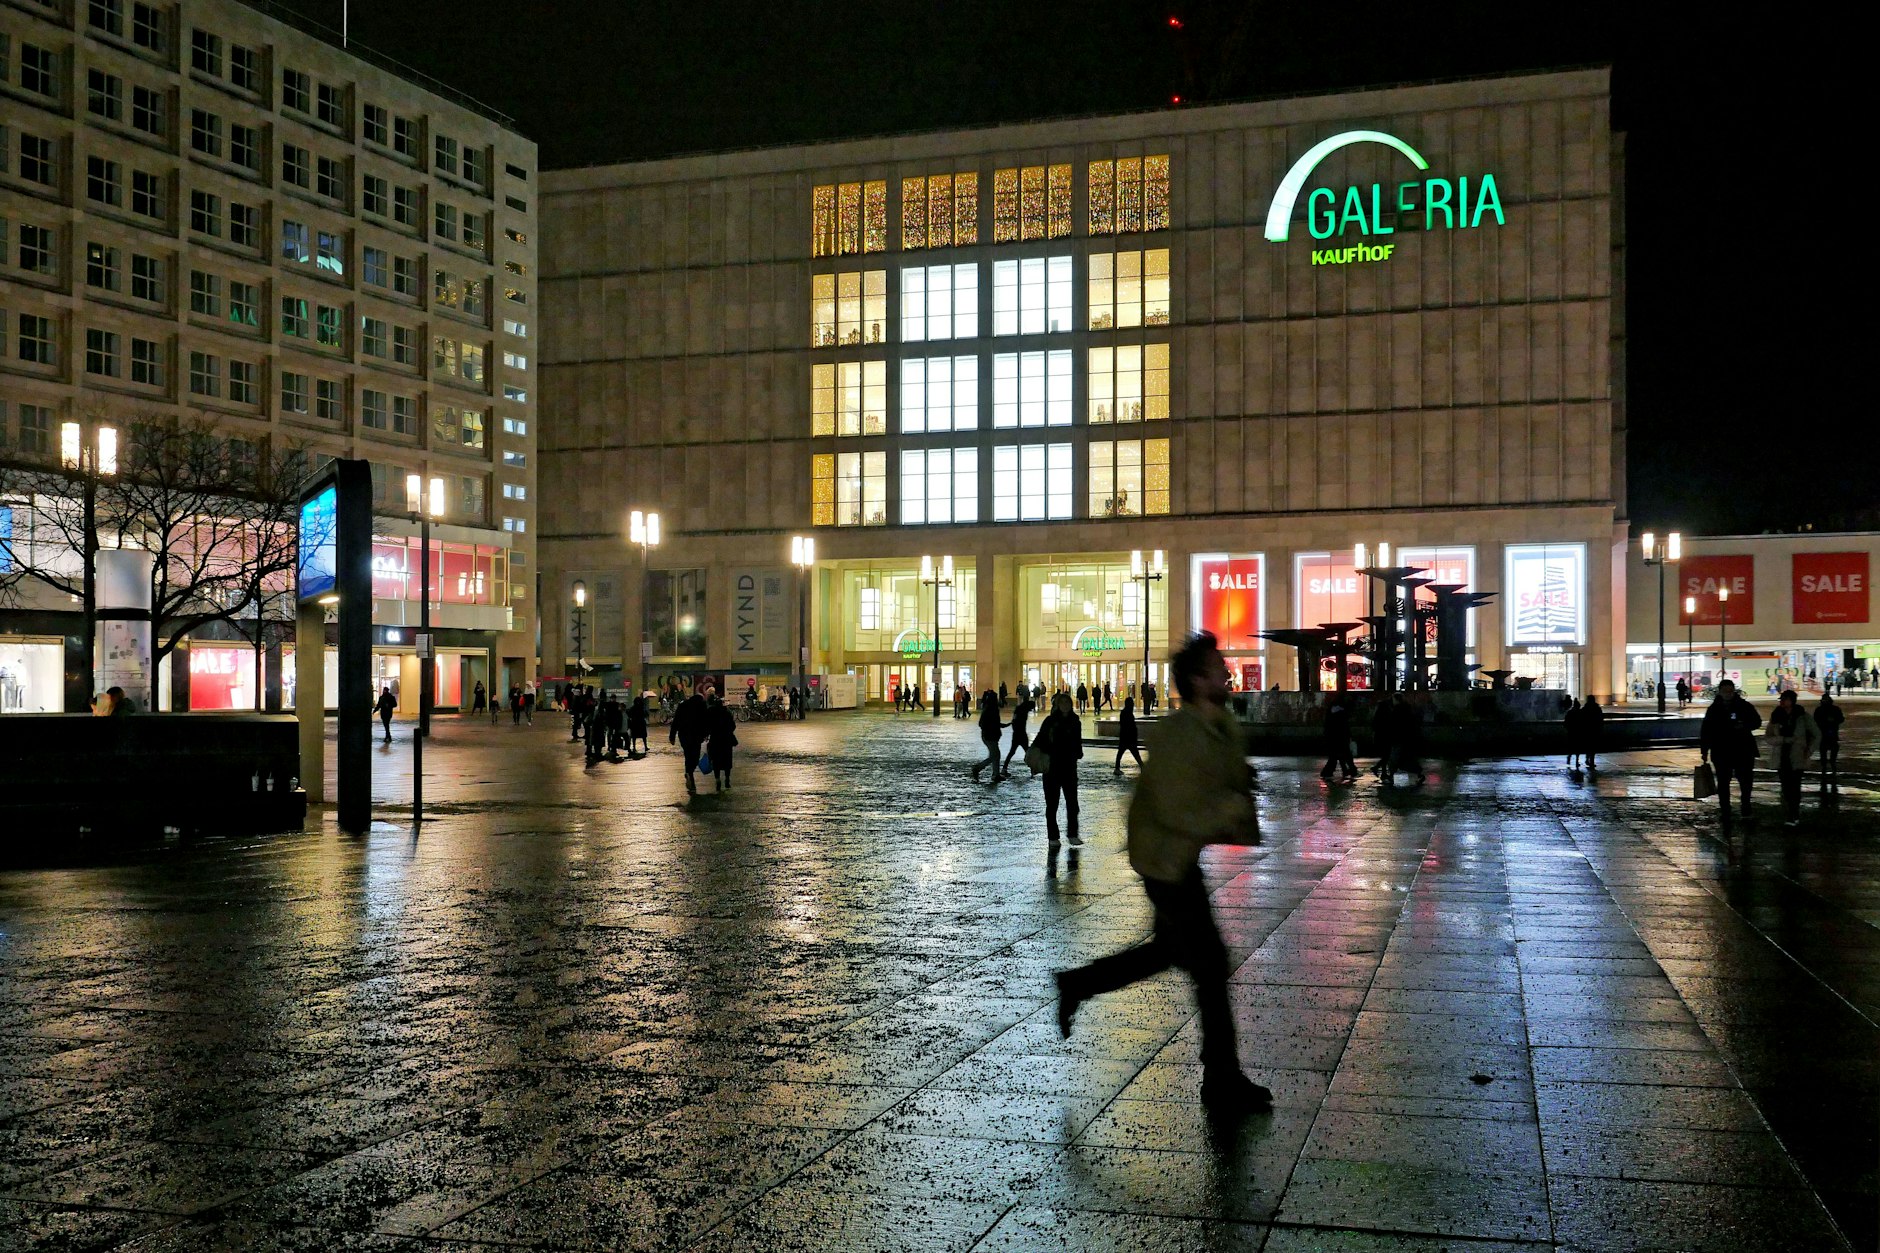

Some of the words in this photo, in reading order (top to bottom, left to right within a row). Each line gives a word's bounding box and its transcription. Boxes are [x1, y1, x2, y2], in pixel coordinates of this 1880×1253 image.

[1308, 173, 1506, 240] GALERIA
[1209, 572, 1258, 591] SALE
[1309, 578, 1358, 594] SALE
[1687, 576, 1746, 595] SALE
[1801, 573, 1862, 593] SALE
[1520, 591, 1569, 608] SALE
[738, 574, 754, 652] MYND
[1082, 637, 1127, 651] GALERIA
